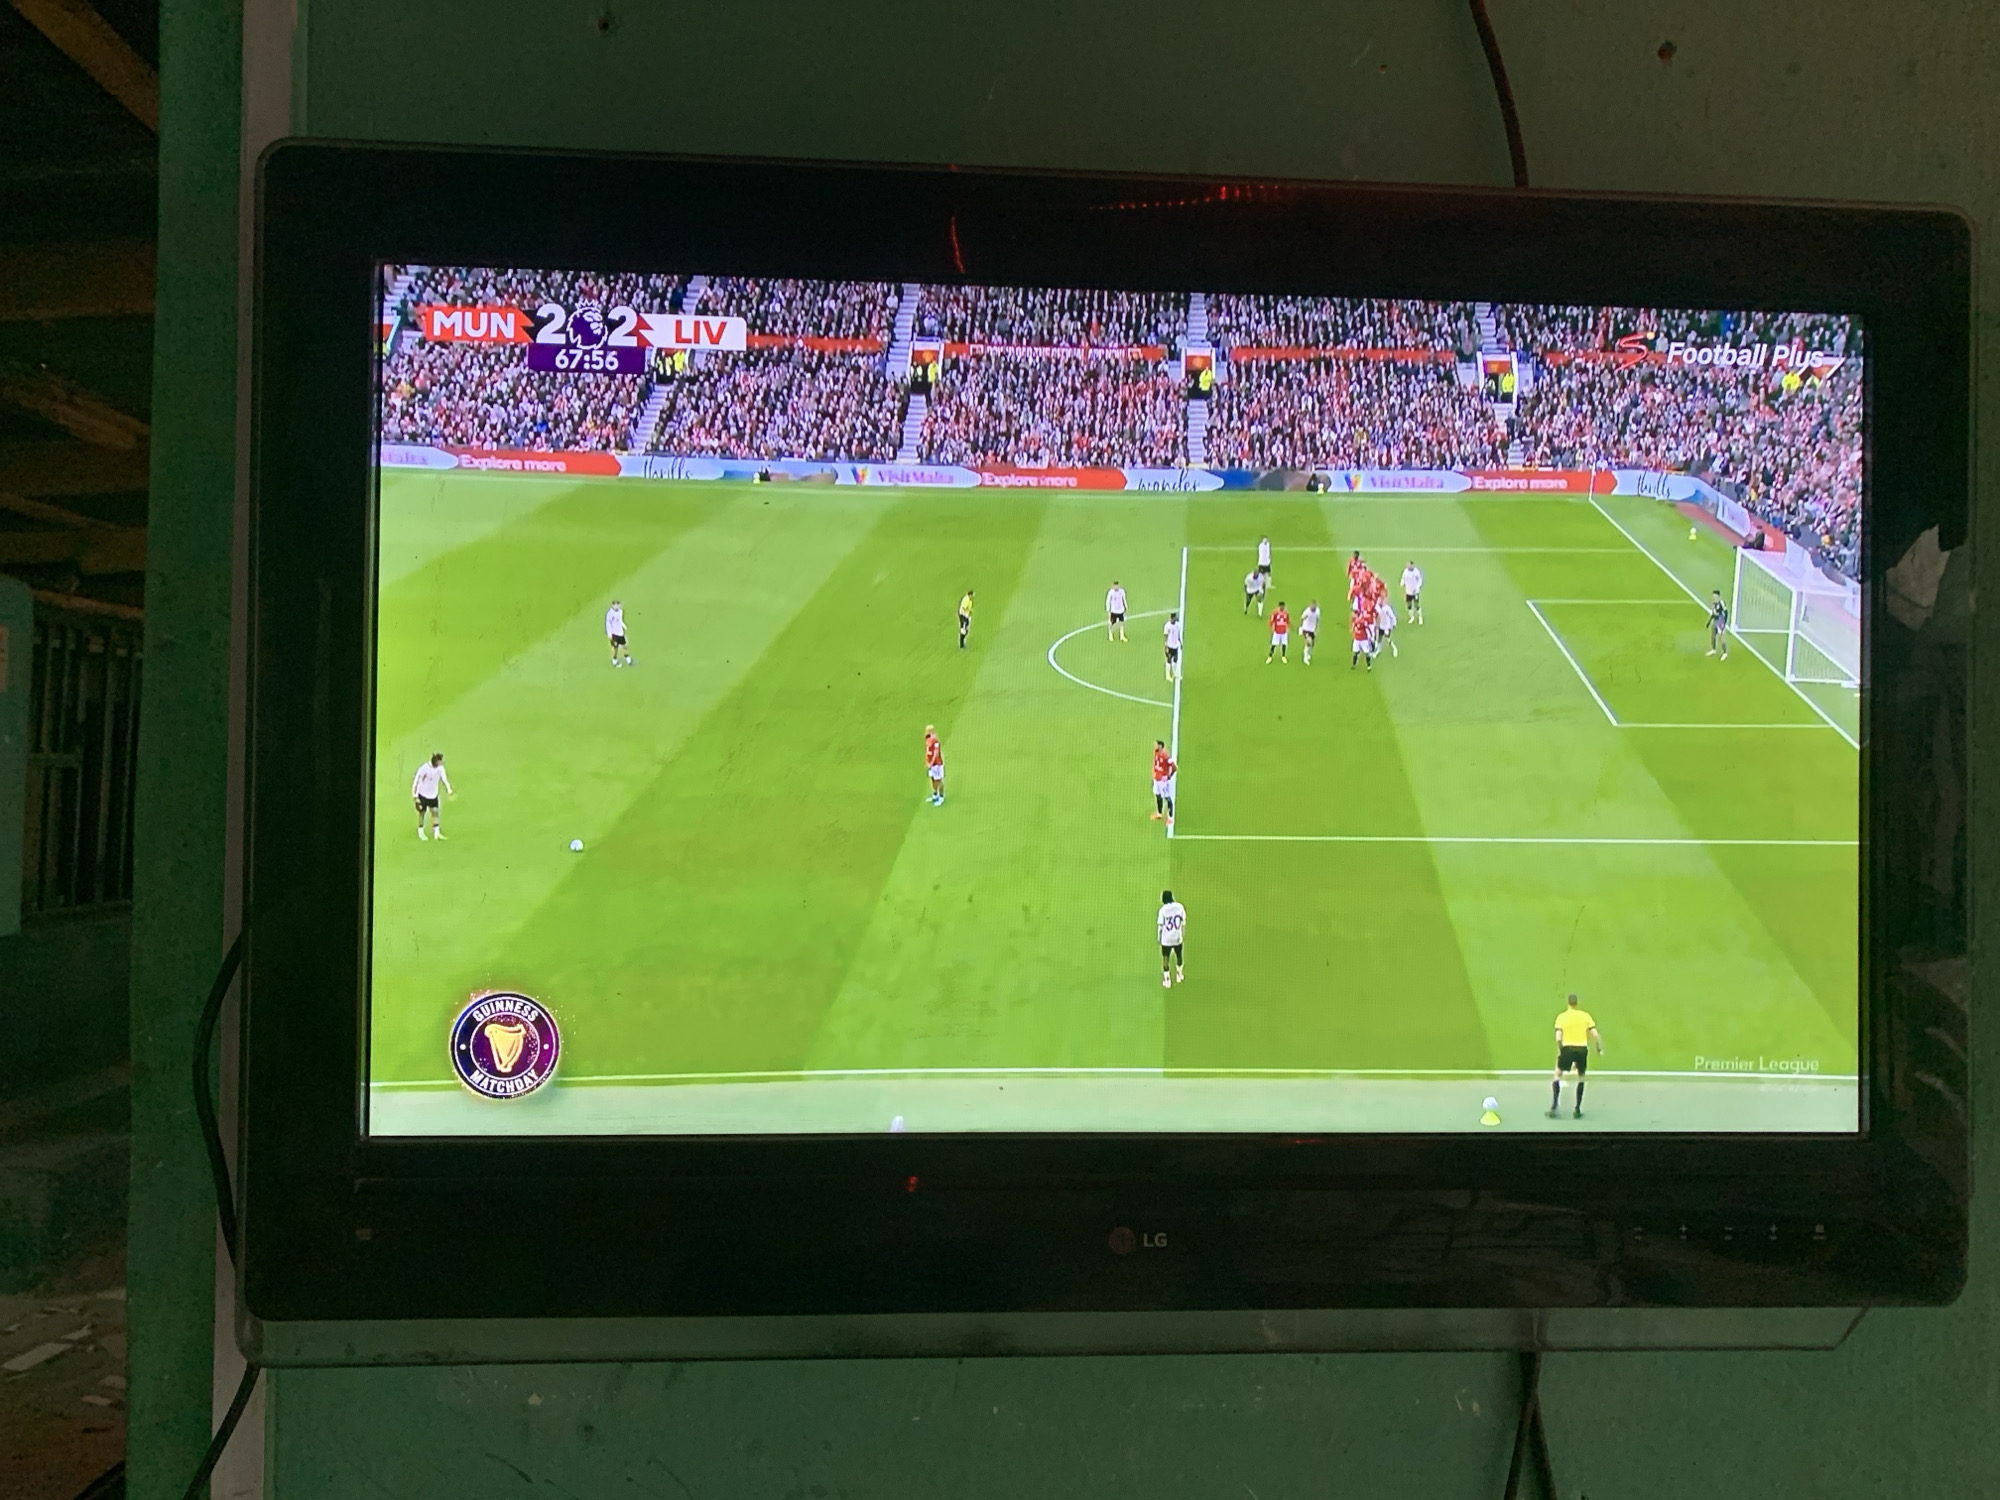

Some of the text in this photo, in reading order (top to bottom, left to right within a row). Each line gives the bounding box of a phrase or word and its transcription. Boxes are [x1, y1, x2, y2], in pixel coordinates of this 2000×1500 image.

[433, 303, 729, 346] MUN 2 2 LIV
[555, 349, 620, 371] 67:56
[1667, 341, 1826, 370] Football Plus
[460, 453, 567, 472] Explore more
[981, 471, 1078, 488] Explore more
[1473, 475, 1568, 491] Explore more
[1166, 914, 1183, 931] 30
[472, 1000, 539, 1022] GUINNESS
[1694, 1055, 1819, 1074] Premier League
[469, 1068, 539, 1093] MATCHDAY
[1143, 1232, 1168, 1248] LG
